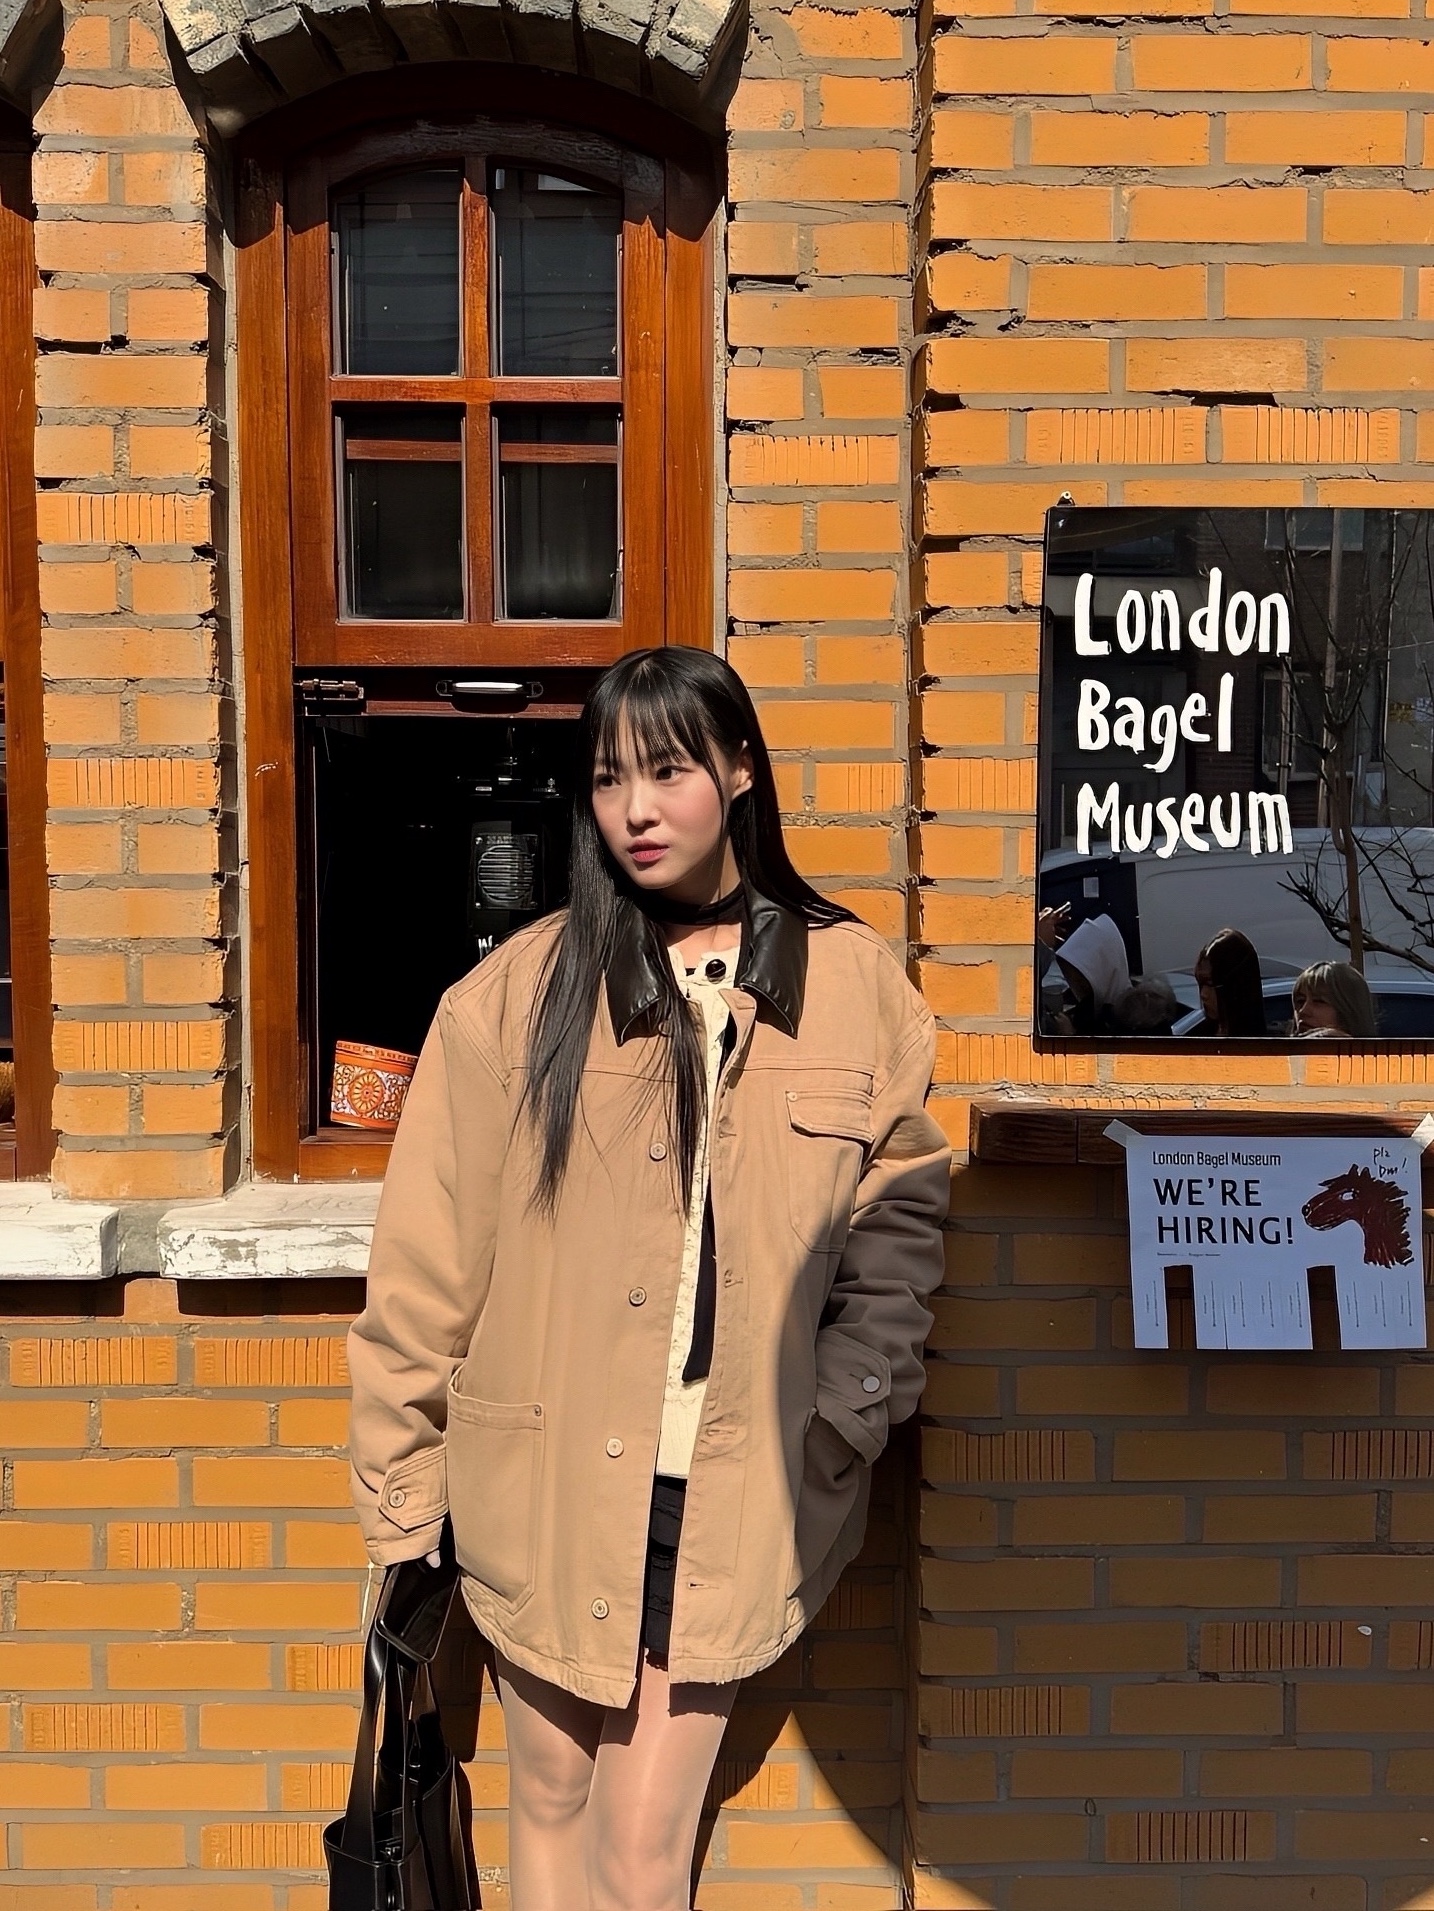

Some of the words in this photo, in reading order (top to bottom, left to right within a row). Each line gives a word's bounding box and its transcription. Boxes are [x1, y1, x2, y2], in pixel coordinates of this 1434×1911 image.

[1075, 568, 1289, 656] London
[1078, 673, 1233, 772] Bagel
[1077, 782, 1292, 858] Museum
[1153, 1150, 1194, 1165] London
[1197, 1151, 1229, 1168] Bagel
[1232, 1152, 1281, 1166] Museum
[1157, 1216, 1294, 1245] HIRING!
